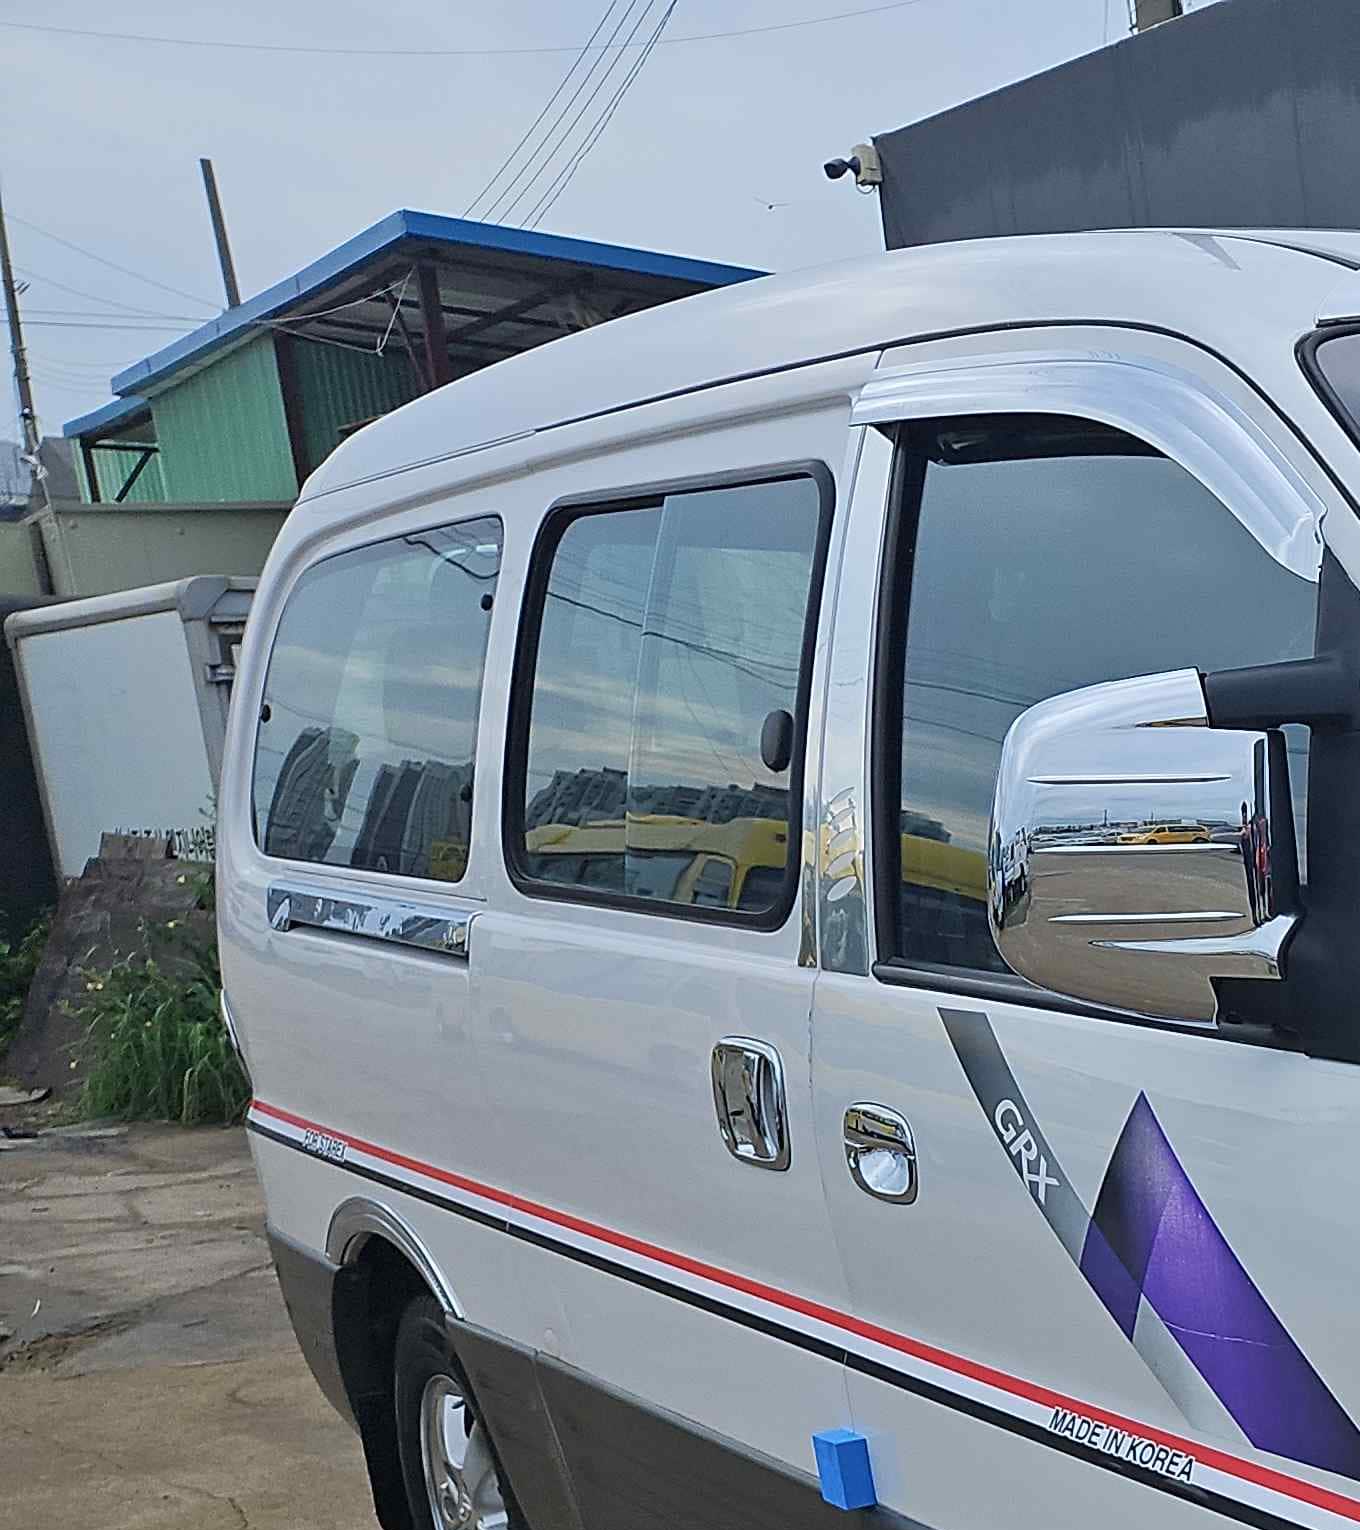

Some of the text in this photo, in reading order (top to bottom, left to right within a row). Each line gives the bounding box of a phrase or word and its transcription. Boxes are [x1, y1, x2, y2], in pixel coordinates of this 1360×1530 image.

[994, 1099, 1060, 1206] GRX
[1048, 1408, 1195, 1482] MADE IN KOREA
